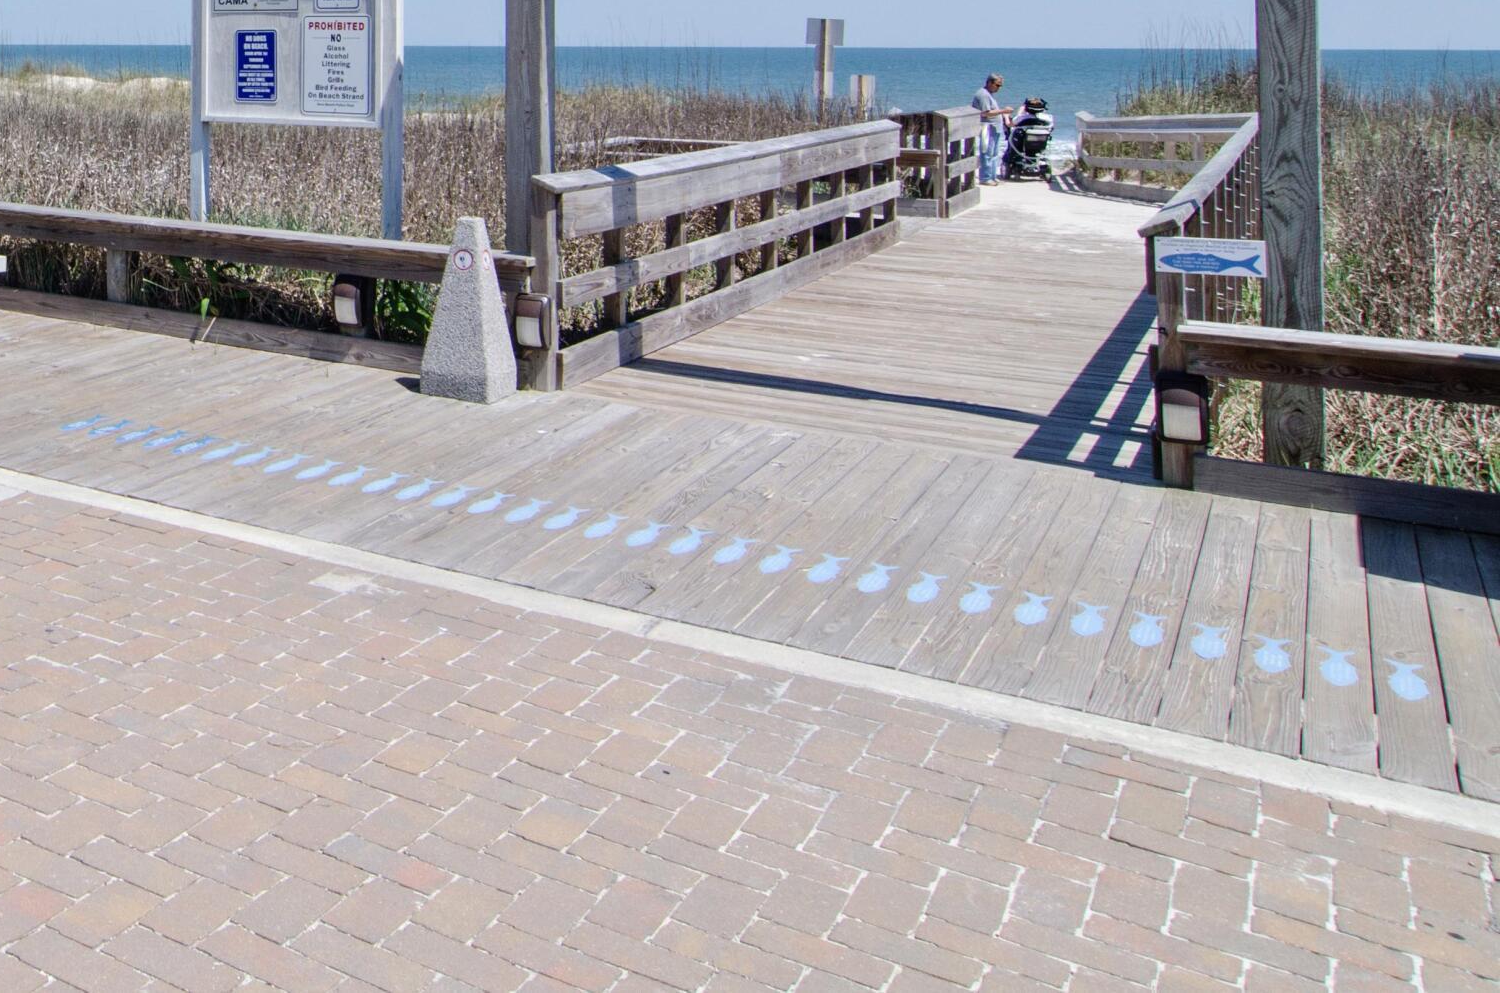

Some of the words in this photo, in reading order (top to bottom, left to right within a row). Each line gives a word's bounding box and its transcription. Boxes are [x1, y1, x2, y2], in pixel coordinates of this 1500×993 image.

[308, 22, 365, 30] PROHIBITED
[330, 34, 342, 42] NO
[330, 85, 357, 93] Feeding
